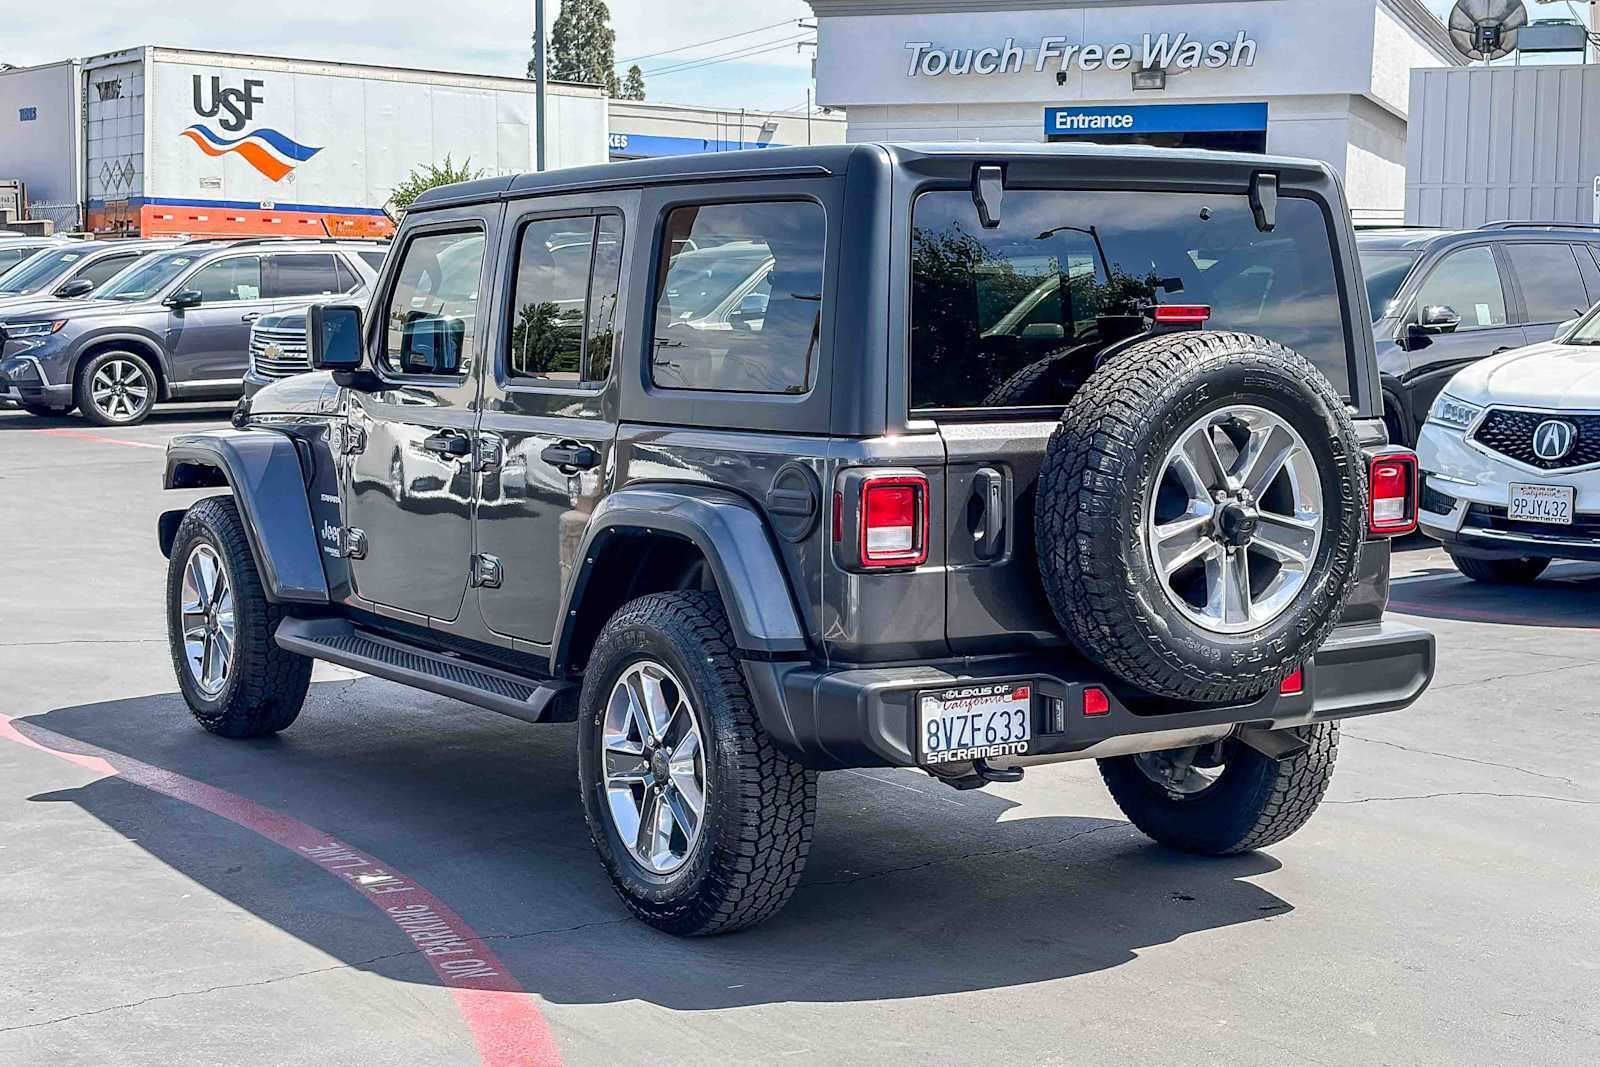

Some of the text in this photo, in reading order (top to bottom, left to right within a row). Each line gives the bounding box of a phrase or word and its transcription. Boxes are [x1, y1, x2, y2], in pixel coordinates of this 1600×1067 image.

[904, 31, 1258, 77] Touch Free Wash
[193, 75, 264, 131] USF
[1055, 111, 1134, 129] Entrance
[1513, 498, 1567, 517] 9PJY432
[943, 694, 1005, 712] California
[954, 685, 1009, 699] LEXUS OF
[927, 709, 1026, 751] 8VZF633
[927, 741, 1028, 764] SACRAMENTO
[298, 842, 370, 870] LANE
[387, 904, 473, 957] PARKING
[440, 958, 499, 979] NO
